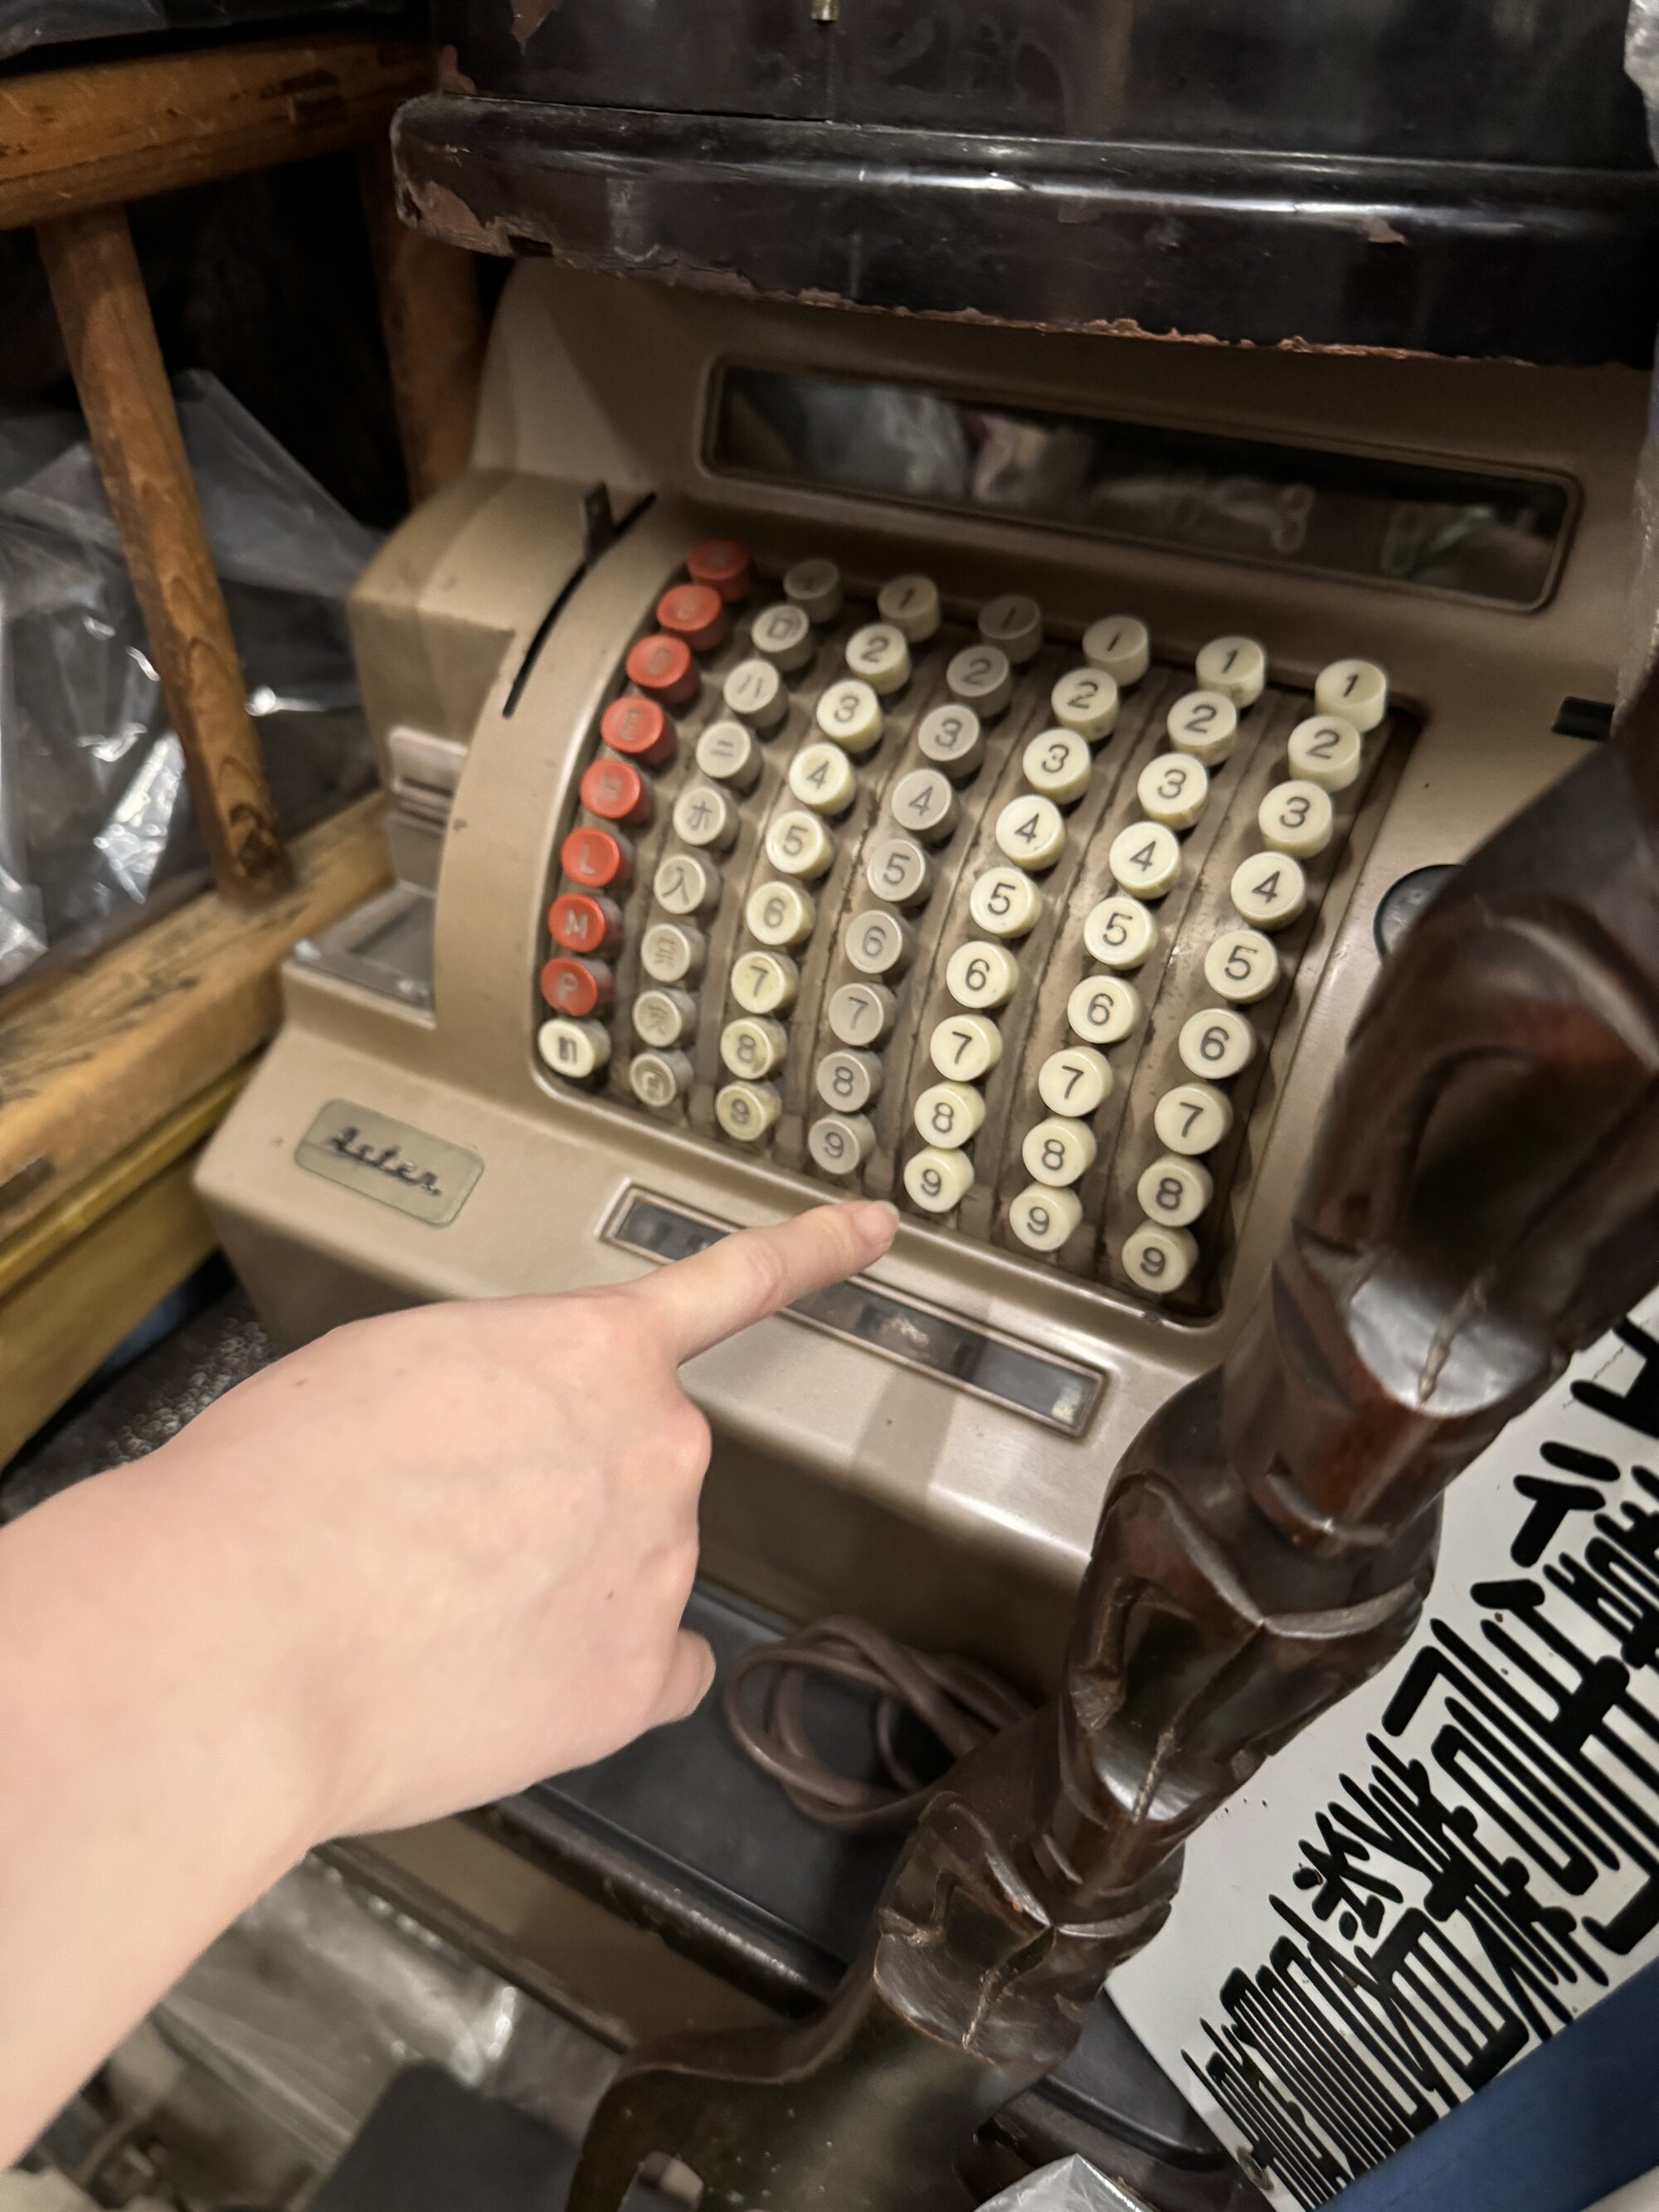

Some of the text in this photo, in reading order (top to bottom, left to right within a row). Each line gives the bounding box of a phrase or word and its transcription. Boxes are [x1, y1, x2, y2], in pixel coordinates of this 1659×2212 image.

[860, 636, 889, 663] 2
[1107, 634, 1120, 652] 1
[961, 658, 992, 684] 2
[1222, 650, 1238, 673] 1
[1067, 680, 1099, 709] 2
[1344, 674, 1359, 697] 1
[834, 694, 859, 723] 3
[1185, 703, 1217, 733] 2
[935, 717, 963, 749] 3
[1306, 729, 1341, 760] 2
[1042, 743, 1070, 774] 3
[807, 761, 830, 789] 4
[1157, 768, 1187, 800] 3
[908, 785, 933, 816] 4
[1280, 796, 1311, 829] 3
[782, 824, 809, 857] 5
[1015, 813, 1039, 843] 4
[580, 843, 596, 873] L
[883, 852, 911, 886] 5
[1130, 840, 1156, 872] 4
[987, 882, 1016, 916] 5
[1253, 871, 1281, 903] 4
[763, 897, 786, 929] 6
[1102, 912, 1132, 946] 5
[862, 926, 886, 958] 6
[966, 959, 990, 991] 6
[1224, 945, 1258, 981] 5
[557, 971, 578, 1002] P
[750, 965, 769, 997] 7
[848, 996, 869, 1029] 7
[1087, 993, 1114, 1026] 6
[737, 1033, 756, 1065] 8
[952, 1031, 972, 1064] 7
[1200, 1026, 1229, 1061] 6
[832, 1066, 854, 1097] 8
[1062, 1066, 1084, 1099] 7
[731, 1098, 750, 1124] 9
[932, 1102, 955, 1134] 8
[1180, 1102, 1204, 1137] 7
[824, 1131, 844, 1159] 9
[1041, 1139, 1065, 1171] 8
[922, 1169, 942, 1197] 9
[1156, 1178, 1183, 1211] 8
[1027, 1206, 1050, 1236] 9
[1141, 1247, 1166, 1276] 9
[1180, 1319, 1659, 2210] 生同業組合員章
